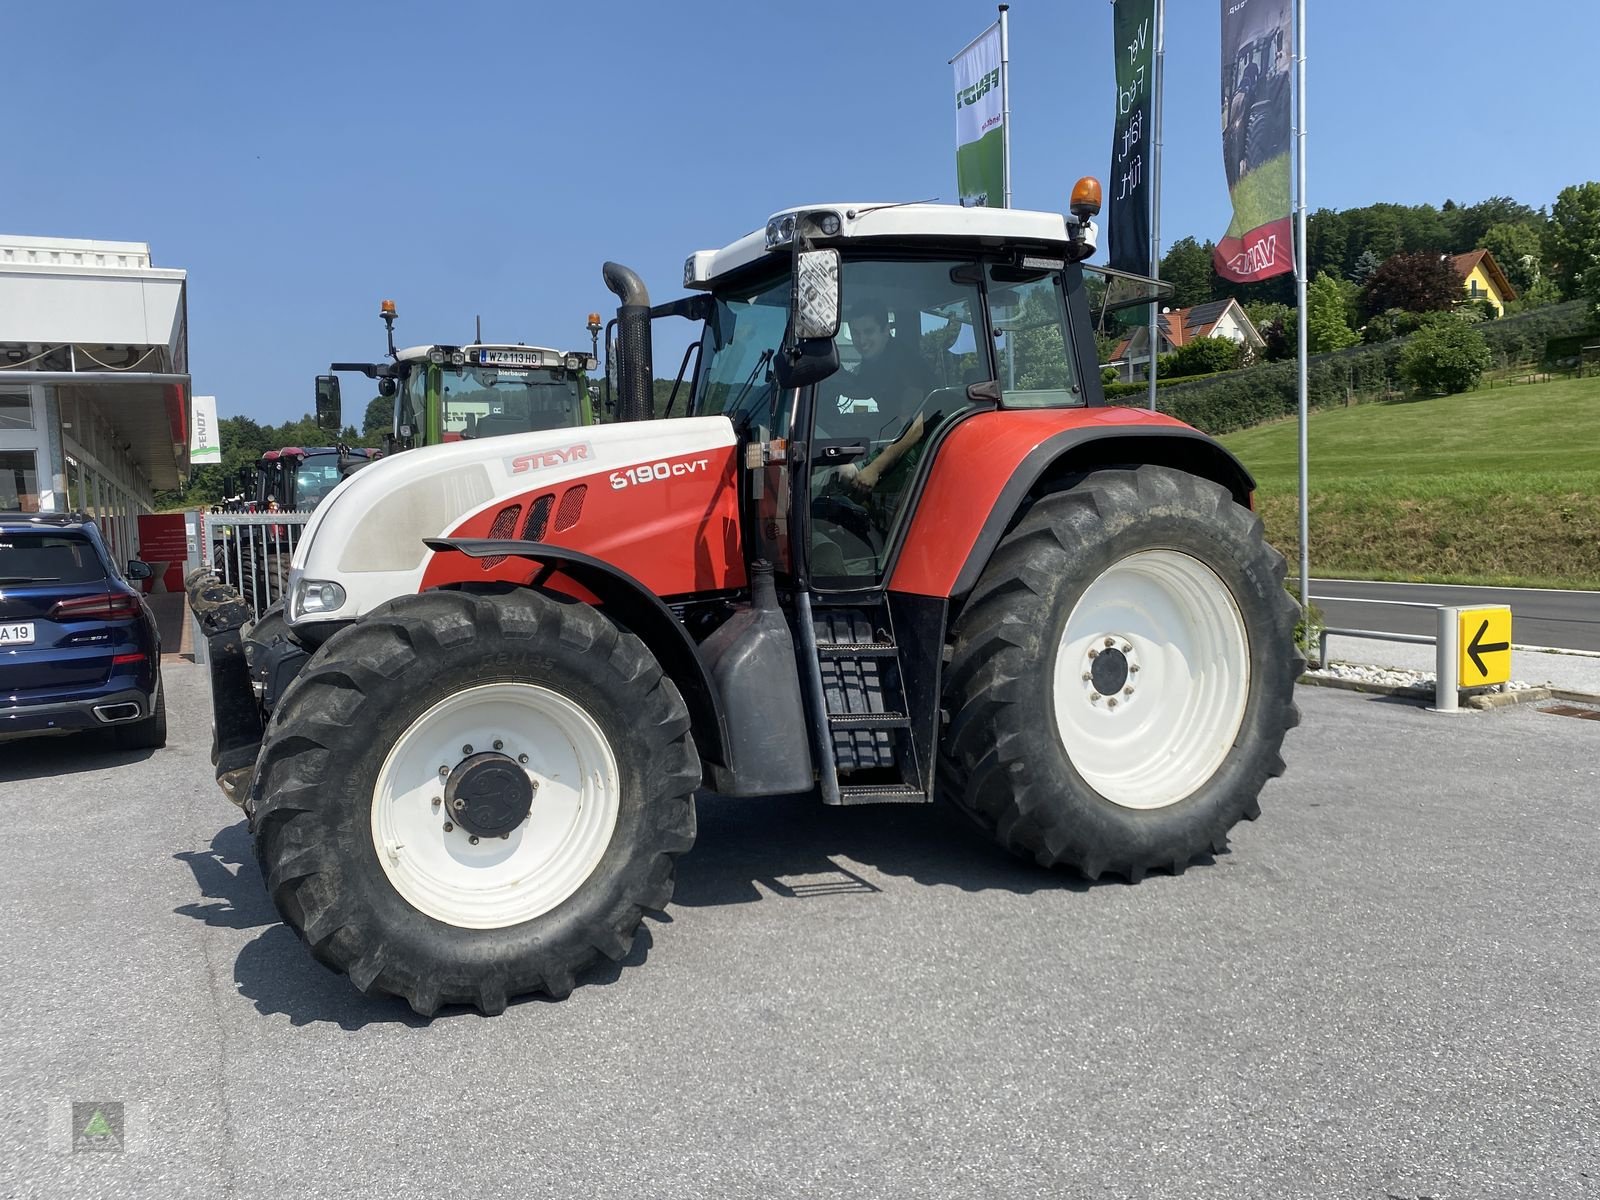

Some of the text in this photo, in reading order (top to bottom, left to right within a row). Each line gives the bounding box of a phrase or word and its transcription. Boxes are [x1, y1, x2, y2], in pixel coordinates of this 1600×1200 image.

[489, 351, 503, 362] WZ
[510, 352, 524, 363] 113
[196, 410, 208, 449] FENDT
[512, 443, 589, 474] STEYR
[672, 459, 709, 476] CVT
[13, 626, 29, 640] 19
